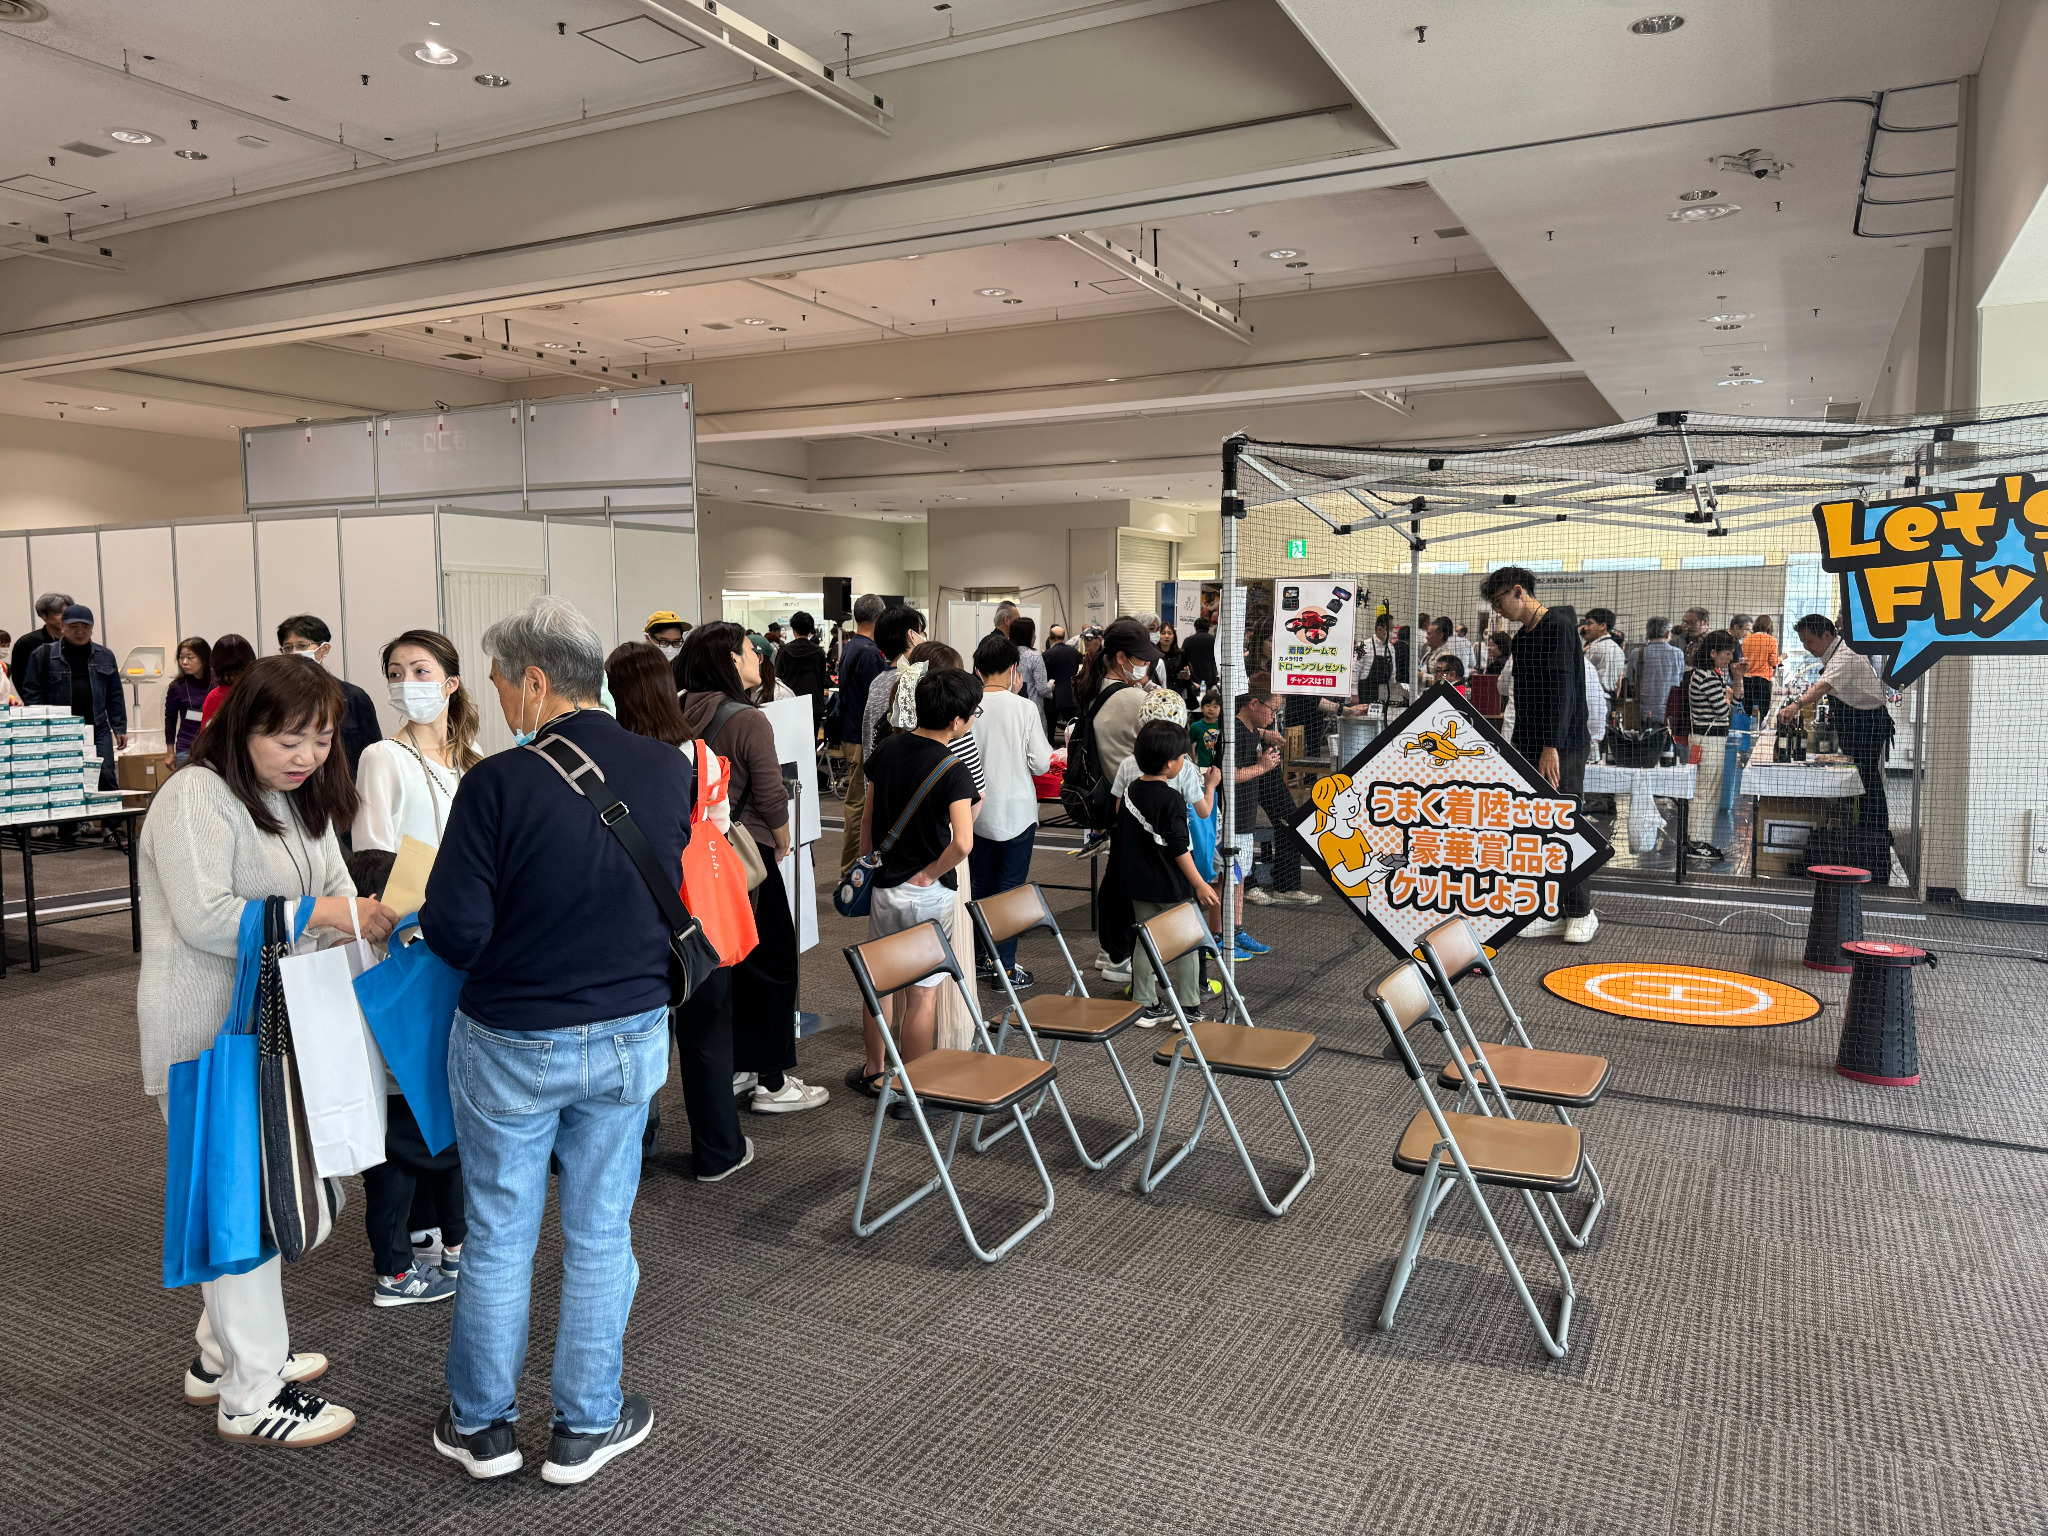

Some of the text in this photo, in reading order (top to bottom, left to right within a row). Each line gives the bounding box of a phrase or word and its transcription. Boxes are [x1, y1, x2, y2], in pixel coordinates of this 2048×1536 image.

[1821, 475, 2048, 558] Let's
[1864, 553, 2048, 624] Fly
[1278, 662, 1347, 673] ドローンプレゼント
[1288, 645, 1338, 656] 着陸ゲームで
[1289, 676, 1334, 686] チャンスは1回
[1373, 788, 1574, 829] うまく着陸させて
[1410, 828, 1566, 875] 豪華賞品を
[1392, 866, 1560, 915] ゲットしよう！
